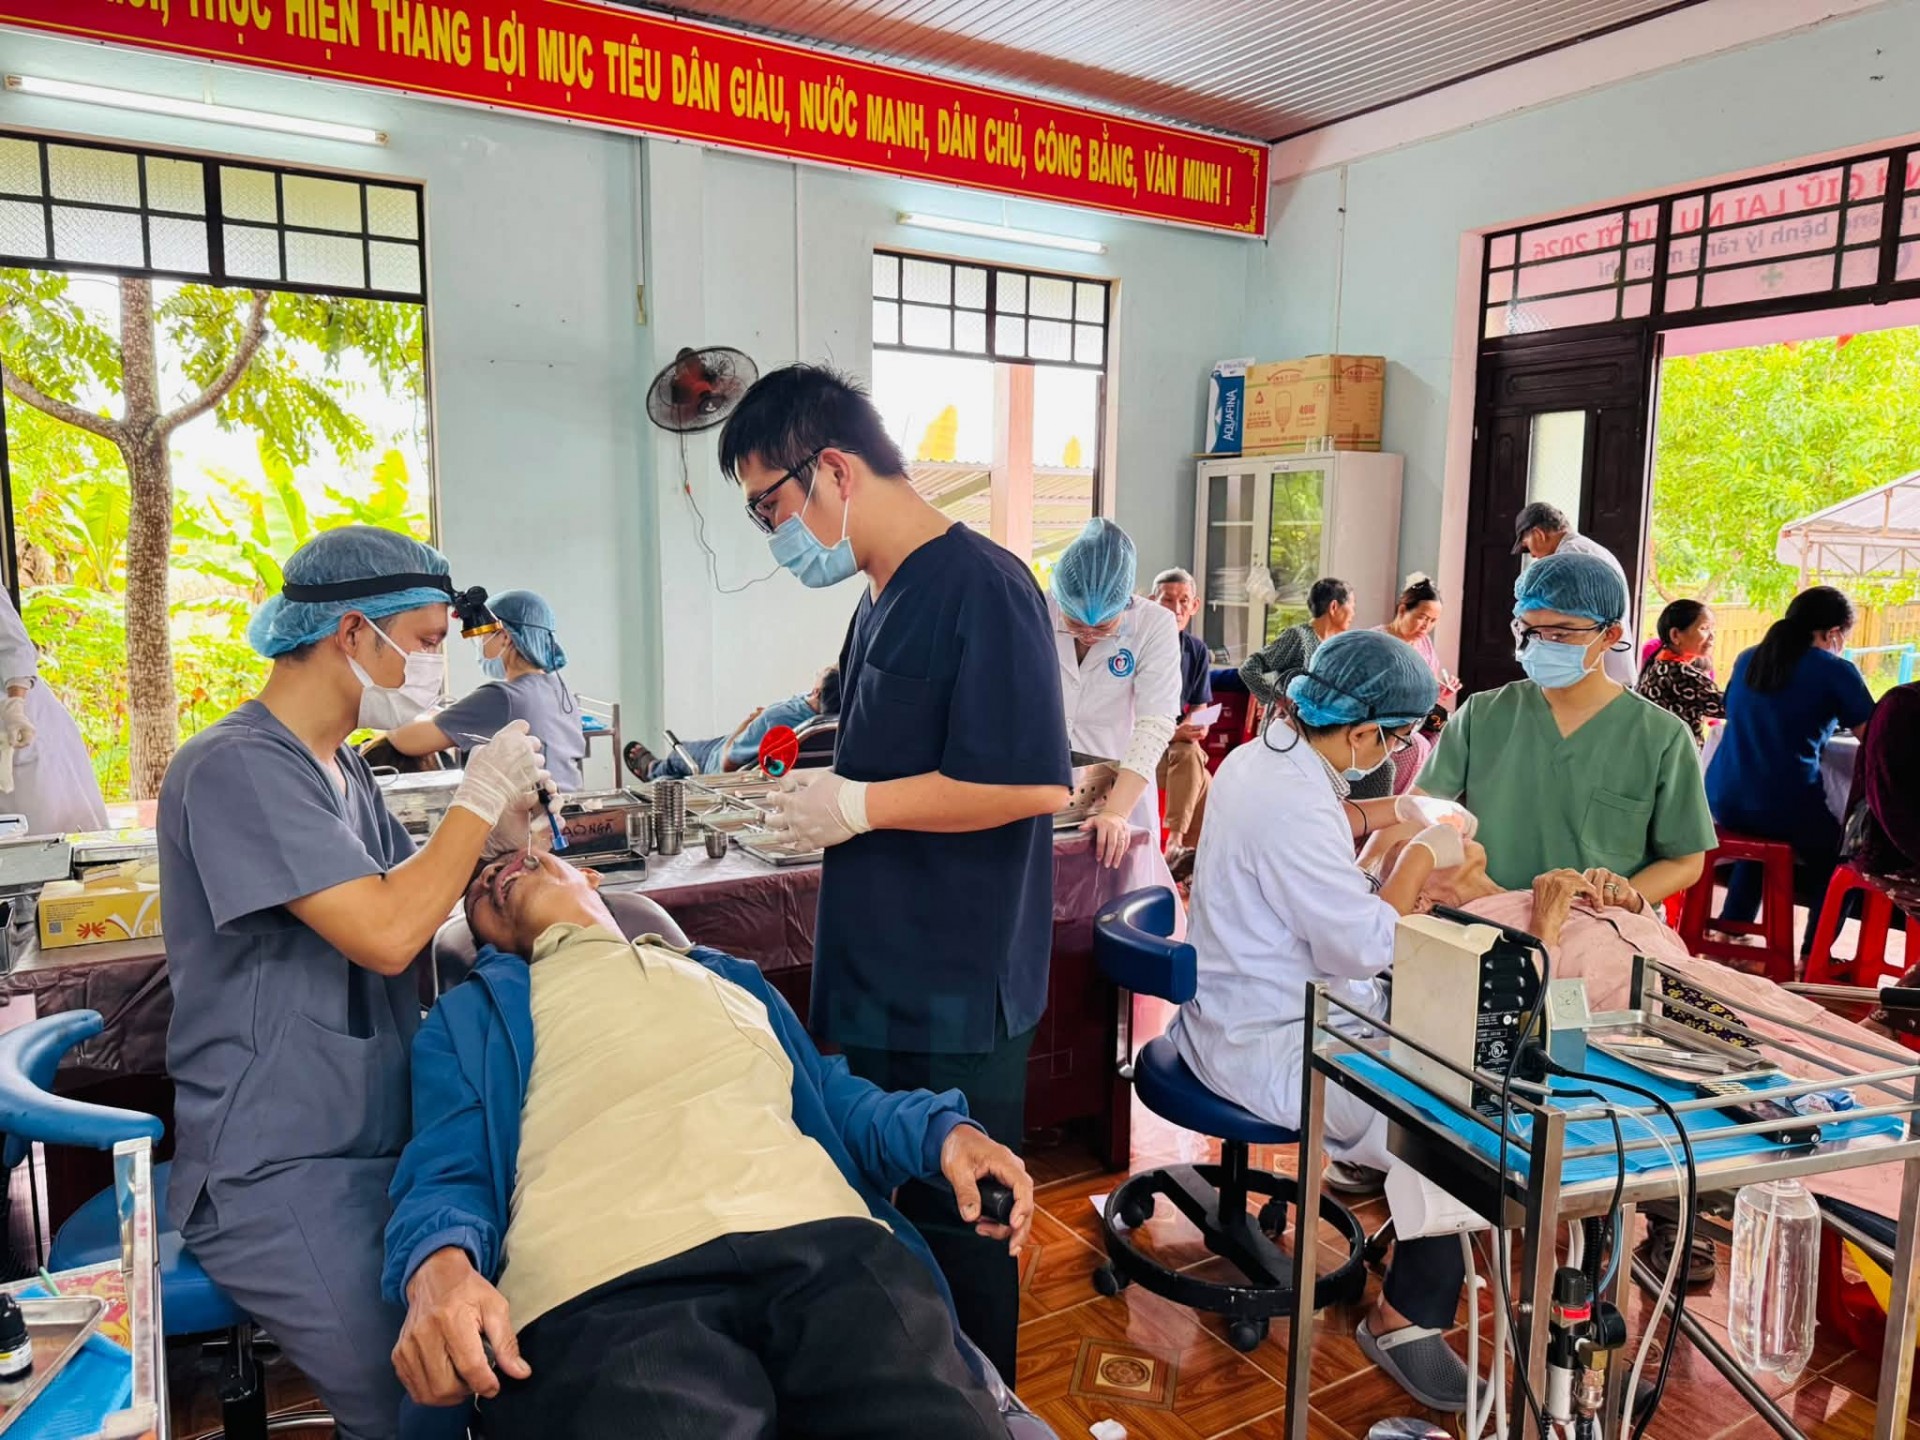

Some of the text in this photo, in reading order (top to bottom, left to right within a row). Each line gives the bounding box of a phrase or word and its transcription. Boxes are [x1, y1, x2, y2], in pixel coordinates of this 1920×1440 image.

[483, 10, 526, 92] LỢI
[537, 27, 594, 102] MỤC
[603, 33, 661, 102] TIÊU
[671, 46, 720, 112] DÂN
[729, 58, 790, 136] GIÀU,
[799, 74, 858, 138] NƯỚC
[866, 94, 930, 161] MẠNH,
[937, 101, 977, 160] DÂN
[984, 108, 1026, 179] CHỦ,
[1034, 120, 1082, 179] CÔNG
[1088, 122, 1138, 199] BẰNG,
[1145, 143, 1177, 196] VĂN
[1182, 158, 1221, 204] MINH
[1222, 387, 1238, 441] AQUAFINA
